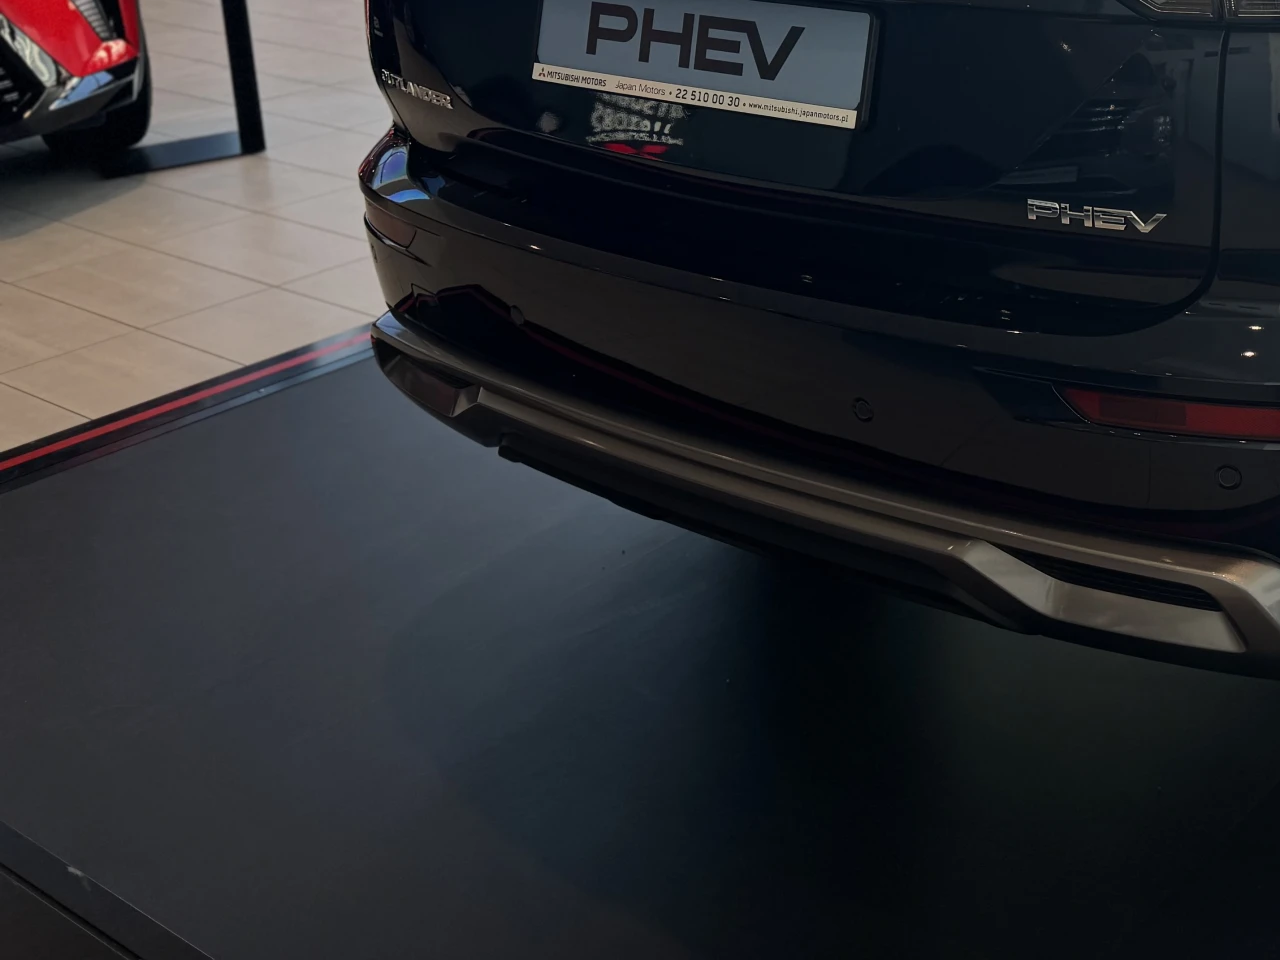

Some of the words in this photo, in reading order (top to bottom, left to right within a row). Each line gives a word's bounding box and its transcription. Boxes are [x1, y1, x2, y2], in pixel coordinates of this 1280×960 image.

[585, 1, 806, 81] PHEV
[546, 69, 581, 84] MITSUBISHI
[581, 76, 607, 87] MOTORS
[614, 80, 637, 93] Japan
[638, 83, 666, 96] Motors
[675, 88, 688, 100] 22
[690, 90, 710, 103] 510
[711, 93, 725, 106] 00
[727, 96, 741, 107] 30
[748, 102, 849, 123] www.mitsubishi.japanmotors.pl
[1027, 198, 1168, 233] PHEV
